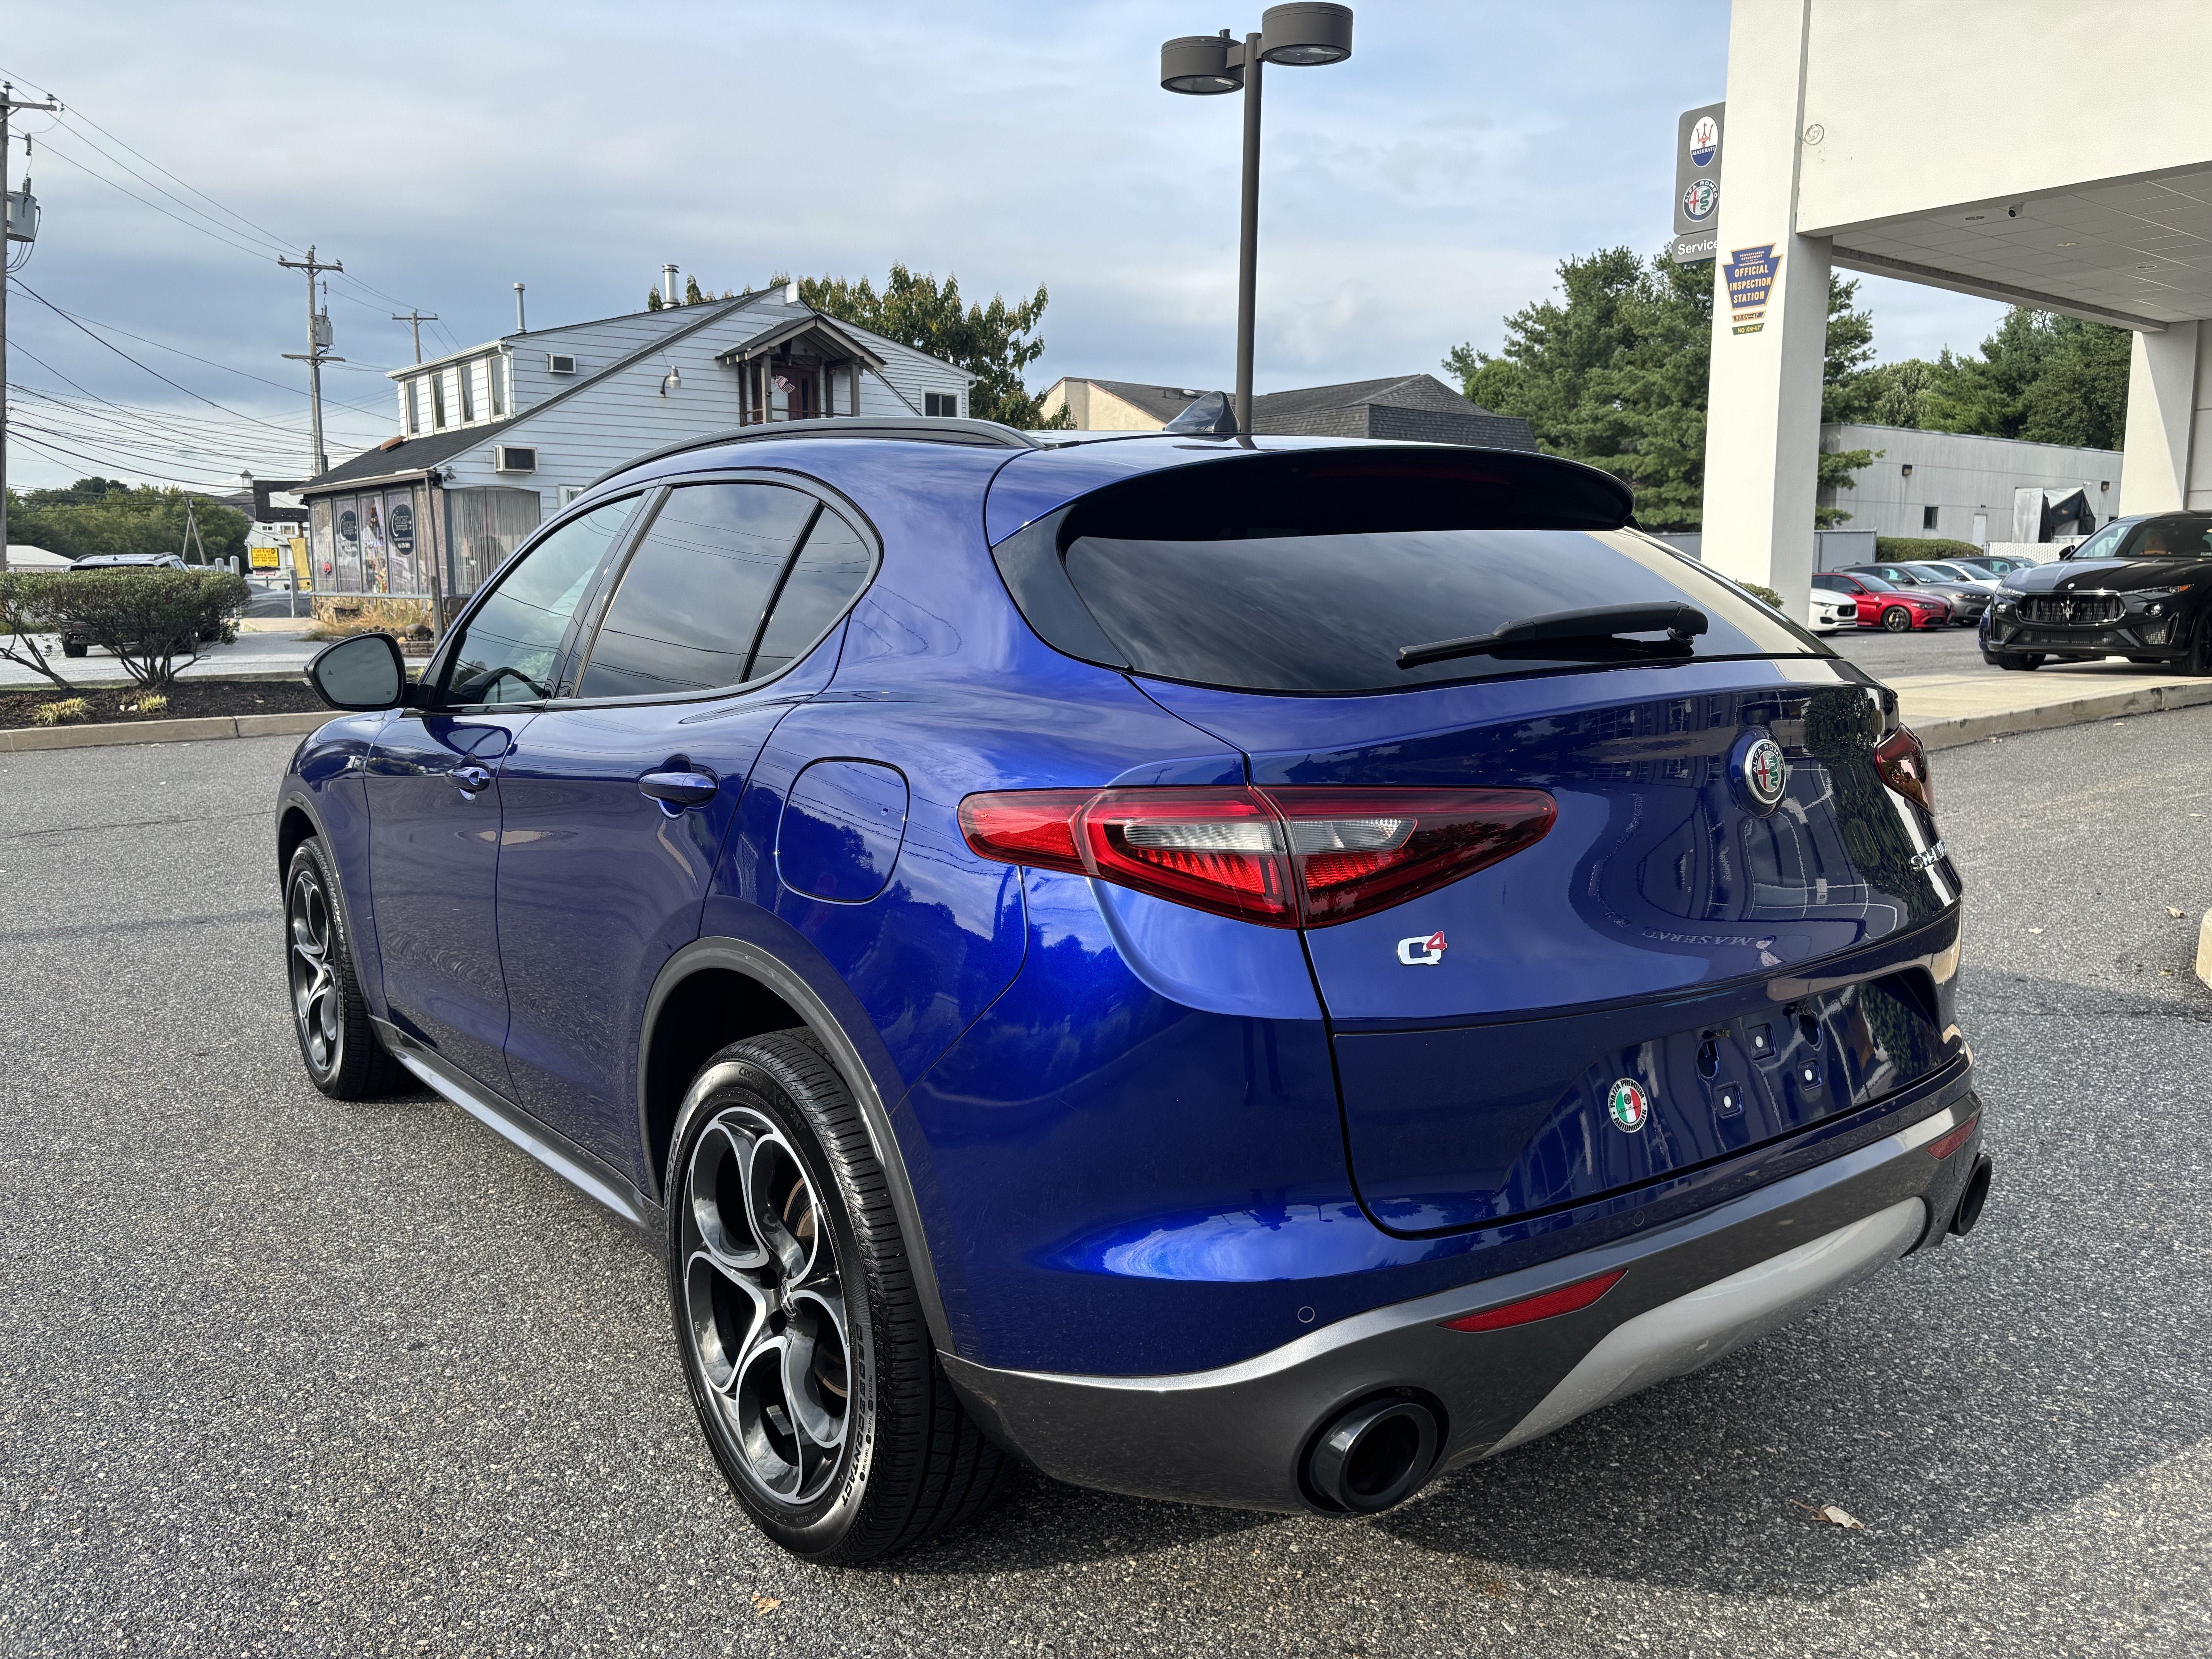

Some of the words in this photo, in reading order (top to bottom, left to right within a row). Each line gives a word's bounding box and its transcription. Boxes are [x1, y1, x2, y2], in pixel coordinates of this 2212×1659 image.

[1692, 146, 1715, 156] MASERATI
[1685, 185, 1697, 204] ALFA
[1700, 180, 1718, 199] ROMEO
[1678, 239, 1718, 255] Service
[1735, 264, 1769, 278] OFFICIAL
[1729, 277, 1771, 291] INSPECTION
[1733, 291, 1764, 304] STATION
[1752, 748, 1763, 773] ALFA
[1764, 744, 1784, 771] ROMEO
[1398, 931, 1448, 965] Q4
[739, 1066, 764, 1084] CROSS
[1610, 1083, 1621, 1108] PIAZZA
[1620, 1079, 1645, 1099] PREMIUM
[1614, 1109, 1647, 1132] AUTOMOBILES
[842, 1322, 866, 1507] CROSSCONTACT
